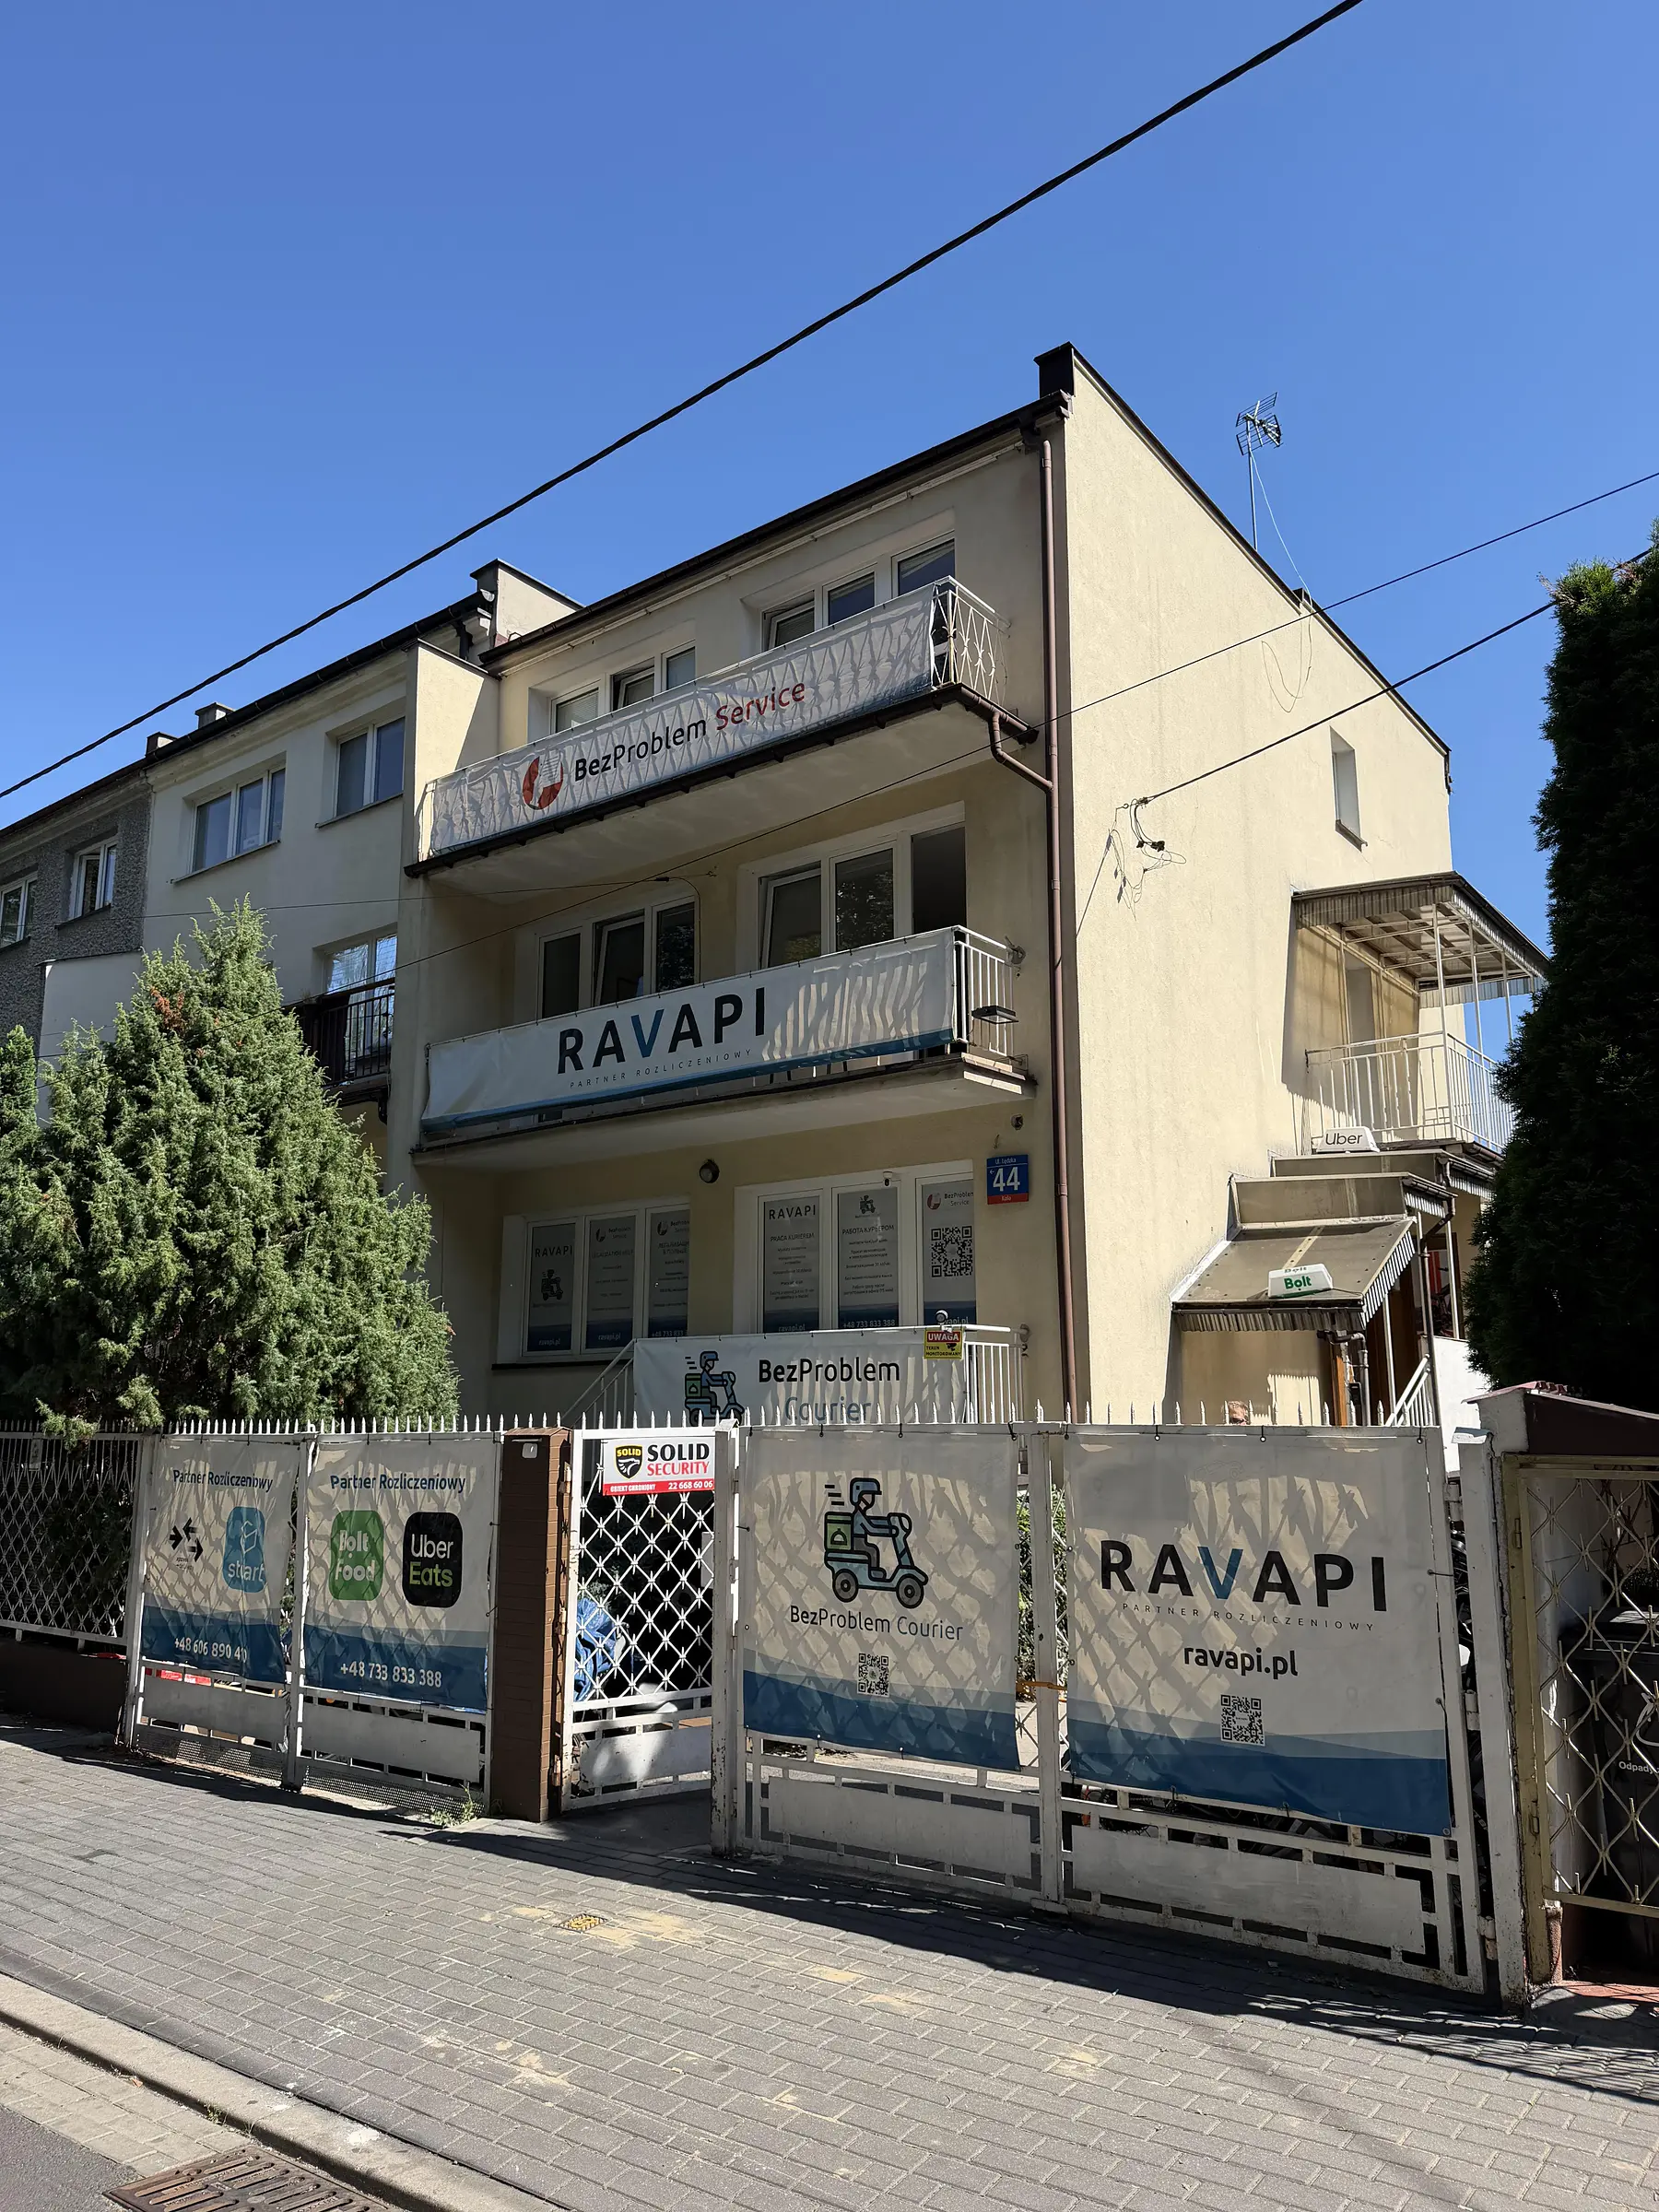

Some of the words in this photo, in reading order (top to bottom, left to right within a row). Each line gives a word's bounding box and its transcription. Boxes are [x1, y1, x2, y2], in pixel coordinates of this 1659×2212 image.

[574, 719, 707, 782] BezProblem
[715, 682, 806, 731] Service
[557, 986, 766, 1075] RAVAPI
[569, 1072, 627, 1088] PARTNER
[636, 1049, 752, 1077] ROZLICZENIOWY
[1325, 1132, 1363, 1146] Uber
[993, 1166, 1020, 1192] 44
[769, 1204, 817, 1220] RAVAPI
[535, 1244, 572, 1258] RAVAPI
[1283, 1276, 1312, 1290] Bolt
[842, 1321, 855, 1329] +48
[869, 1320, 882, 1328] 833
[882, 1319, 896, 1327] 388
[927, 1333, 959, 1341] UWAGA
[759, 1357, 900, 1383] BezProblem
[784, 1396, 872, 1422] Courier
[616, 1448, 641, 1457] SOLID
[647, 1443, 710, 1462] SOLID
[173, 1469, 206, 1485] Partner
[646, 1461, 710, 1477] SECURITY
[330, 1475, 377, 1489] Partner
[379, 1474, 466, 1494] Rozliczeniowy
[668, 1482, 677, 1490] 22
[678, 1481, 693, 1489] 668
[703, 1480, 713, 1488] 06
[411, 1533, 454, 1559] Uber
[409, 1561, 453, 1587] Eats
[1100, 1539, 1388, 1612] RAVAPI
[790, 1605, 891, 1633] BezProblem
[897, 1616, 964, 1641] Courier
[1122, 1603, 1200, 1618] PARTNER
[1213, 1610, 1375, 1631] ROZLICZENIOWY
[174, 1636, 192, 1652] +48
[193, 1639, 208, 1656] 606
[211, 1642, 231, 1659] 890
[1183, 1645, 1300, 1680] ravapi.pl
[340, 1661, 366, 1677] +48
[368, 1663, 388, 1681] 733
[392, 1665, 416, 1684] 833
[419, 1669, 442, 1688] 388
[1618, 1760, 1655, 1774] Odpady
